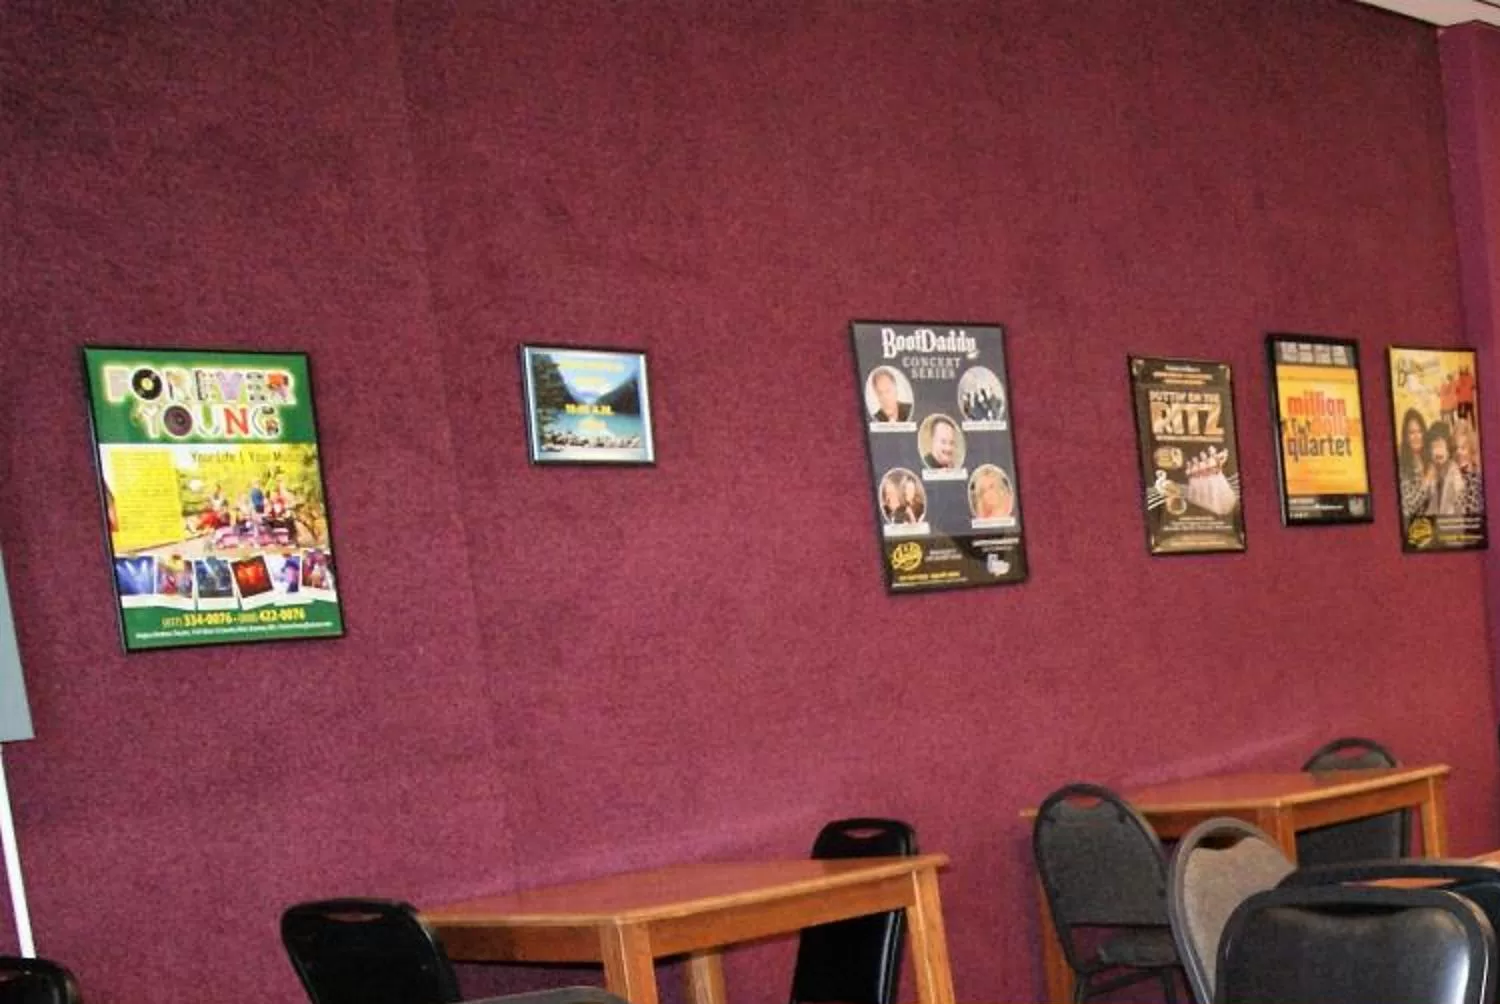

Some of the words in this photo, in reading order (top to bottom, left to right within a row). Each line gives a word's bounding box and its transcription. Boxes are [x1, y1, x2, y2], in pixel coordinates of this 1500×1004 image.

[902, 356, 960, 368] CONCERT
[105, 367, 295, 403] FOREVER
[1150, 402, 1224, 435] RITZ
[1287, 390, 1347, 417] million
[141, 404, 281, 438] YOUNG
[1287, 434, 1353, 463] quartet
